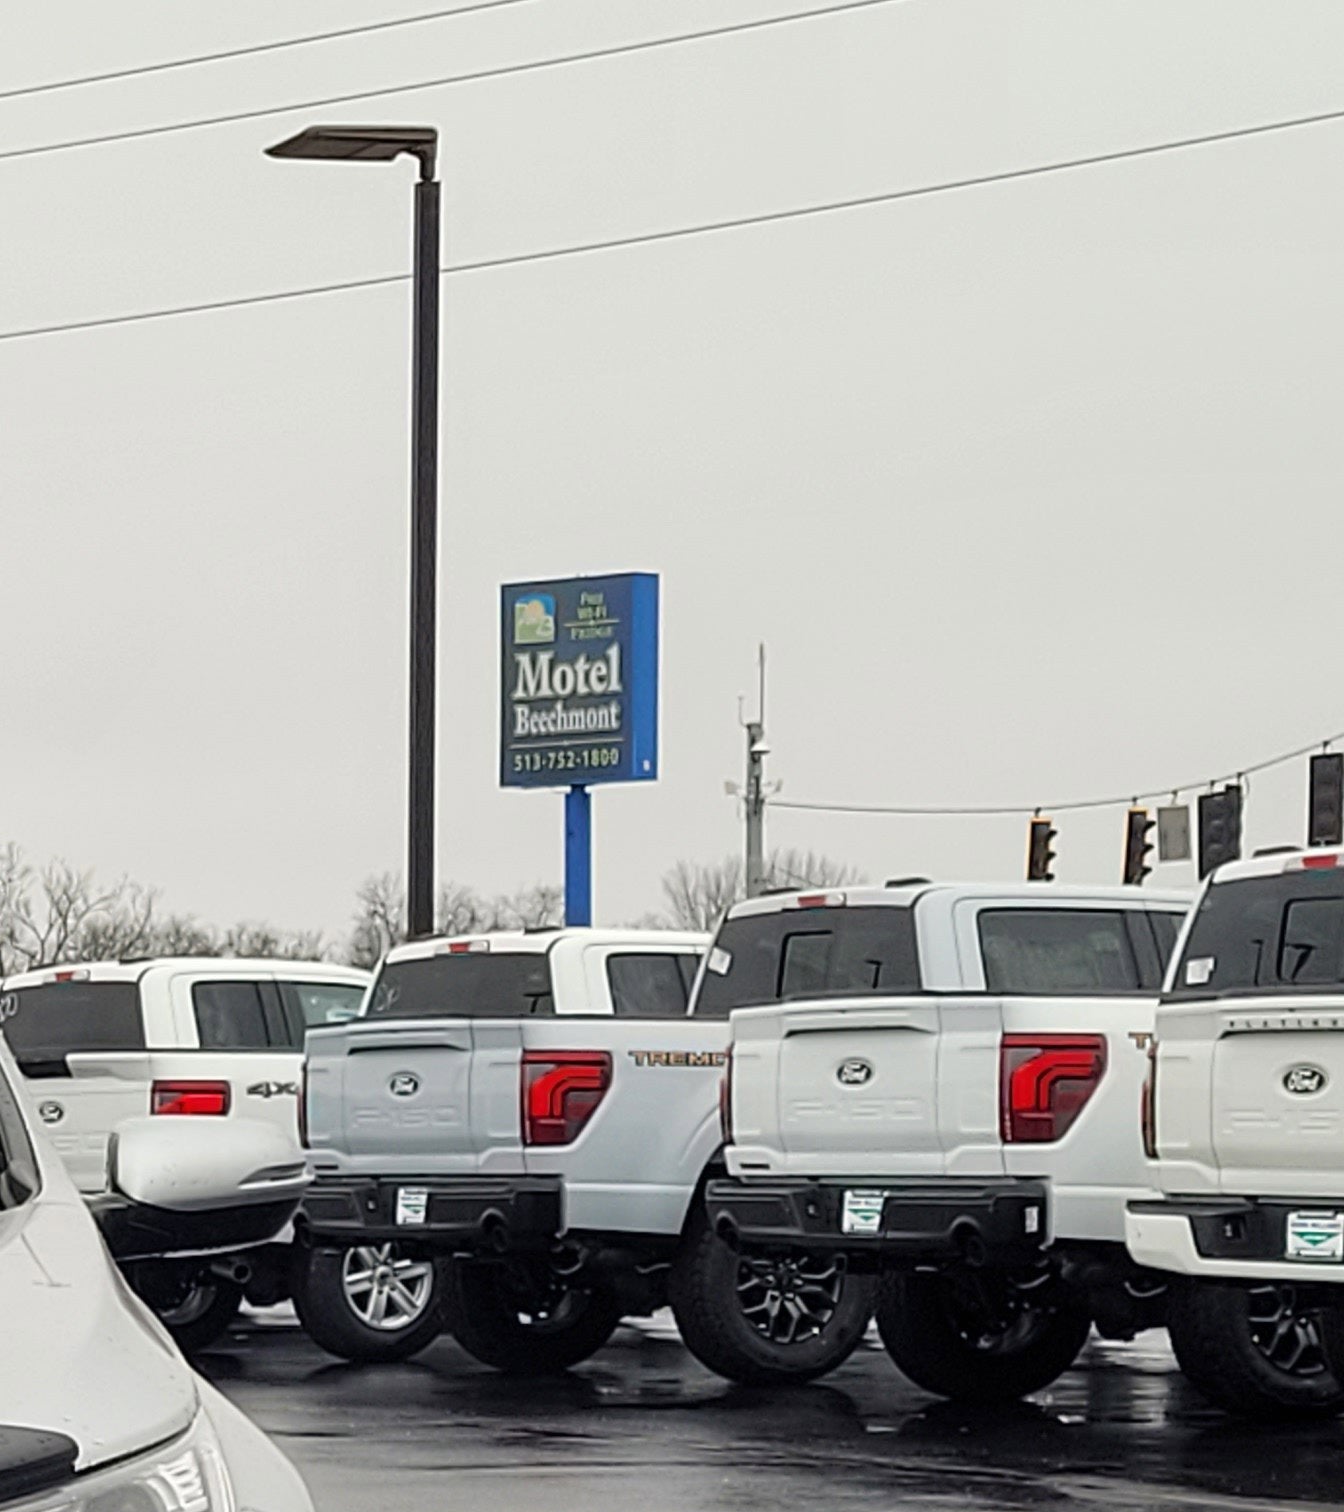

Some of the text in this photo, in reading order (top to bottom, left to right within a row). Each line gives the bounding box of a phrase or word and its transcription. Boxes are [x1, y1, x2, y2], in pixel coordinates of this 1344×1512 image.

[513, 641, 623, 699] Motel
[514, 700, 621, 738] Beechmont
[1228, 1018, 1340, 1029] PLATINU
